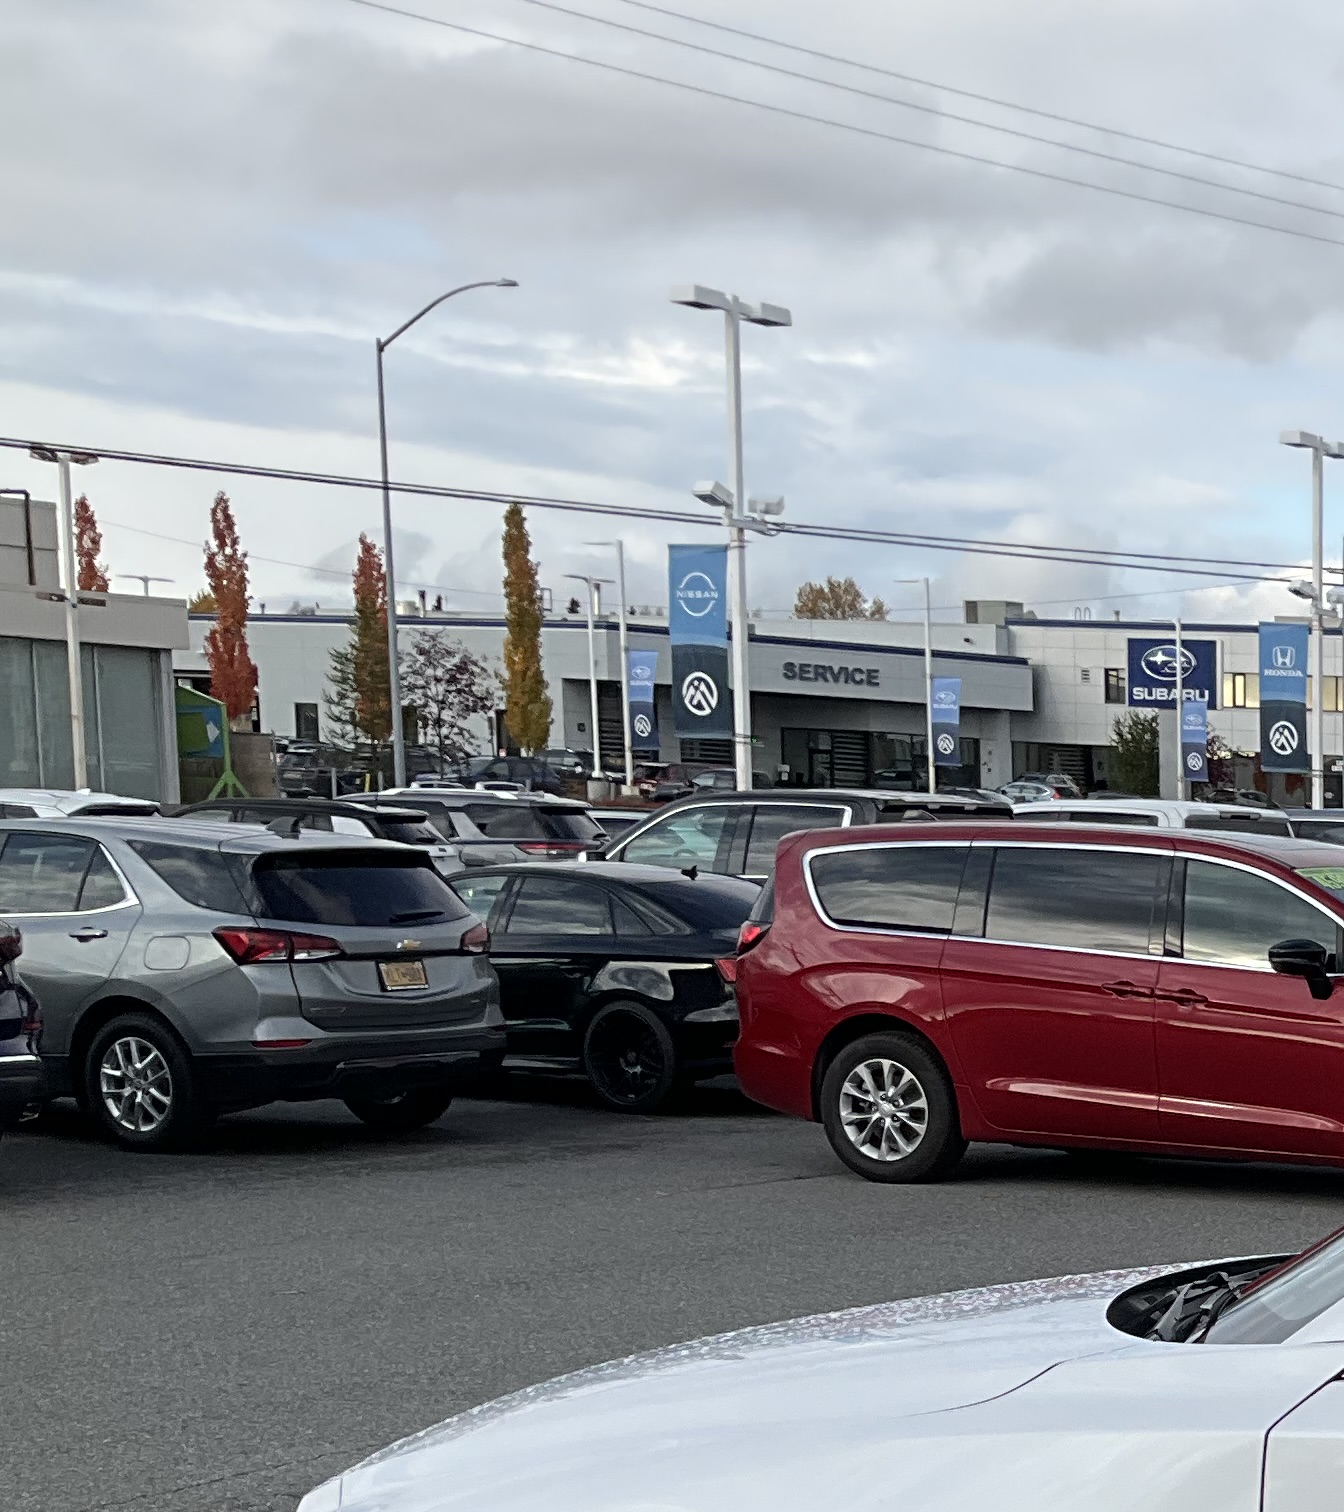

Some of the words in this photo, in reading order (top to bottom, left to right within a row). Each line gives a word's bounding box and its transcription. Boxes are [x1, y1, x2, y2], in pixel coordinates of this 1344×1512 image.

[677, 590, 719, 599] NISSAN
[782, 661, 881, 688] SERVICE
[1264, 669, 1304, 677] HONDA
[1132, 687, 1209, 702] SUBARU
